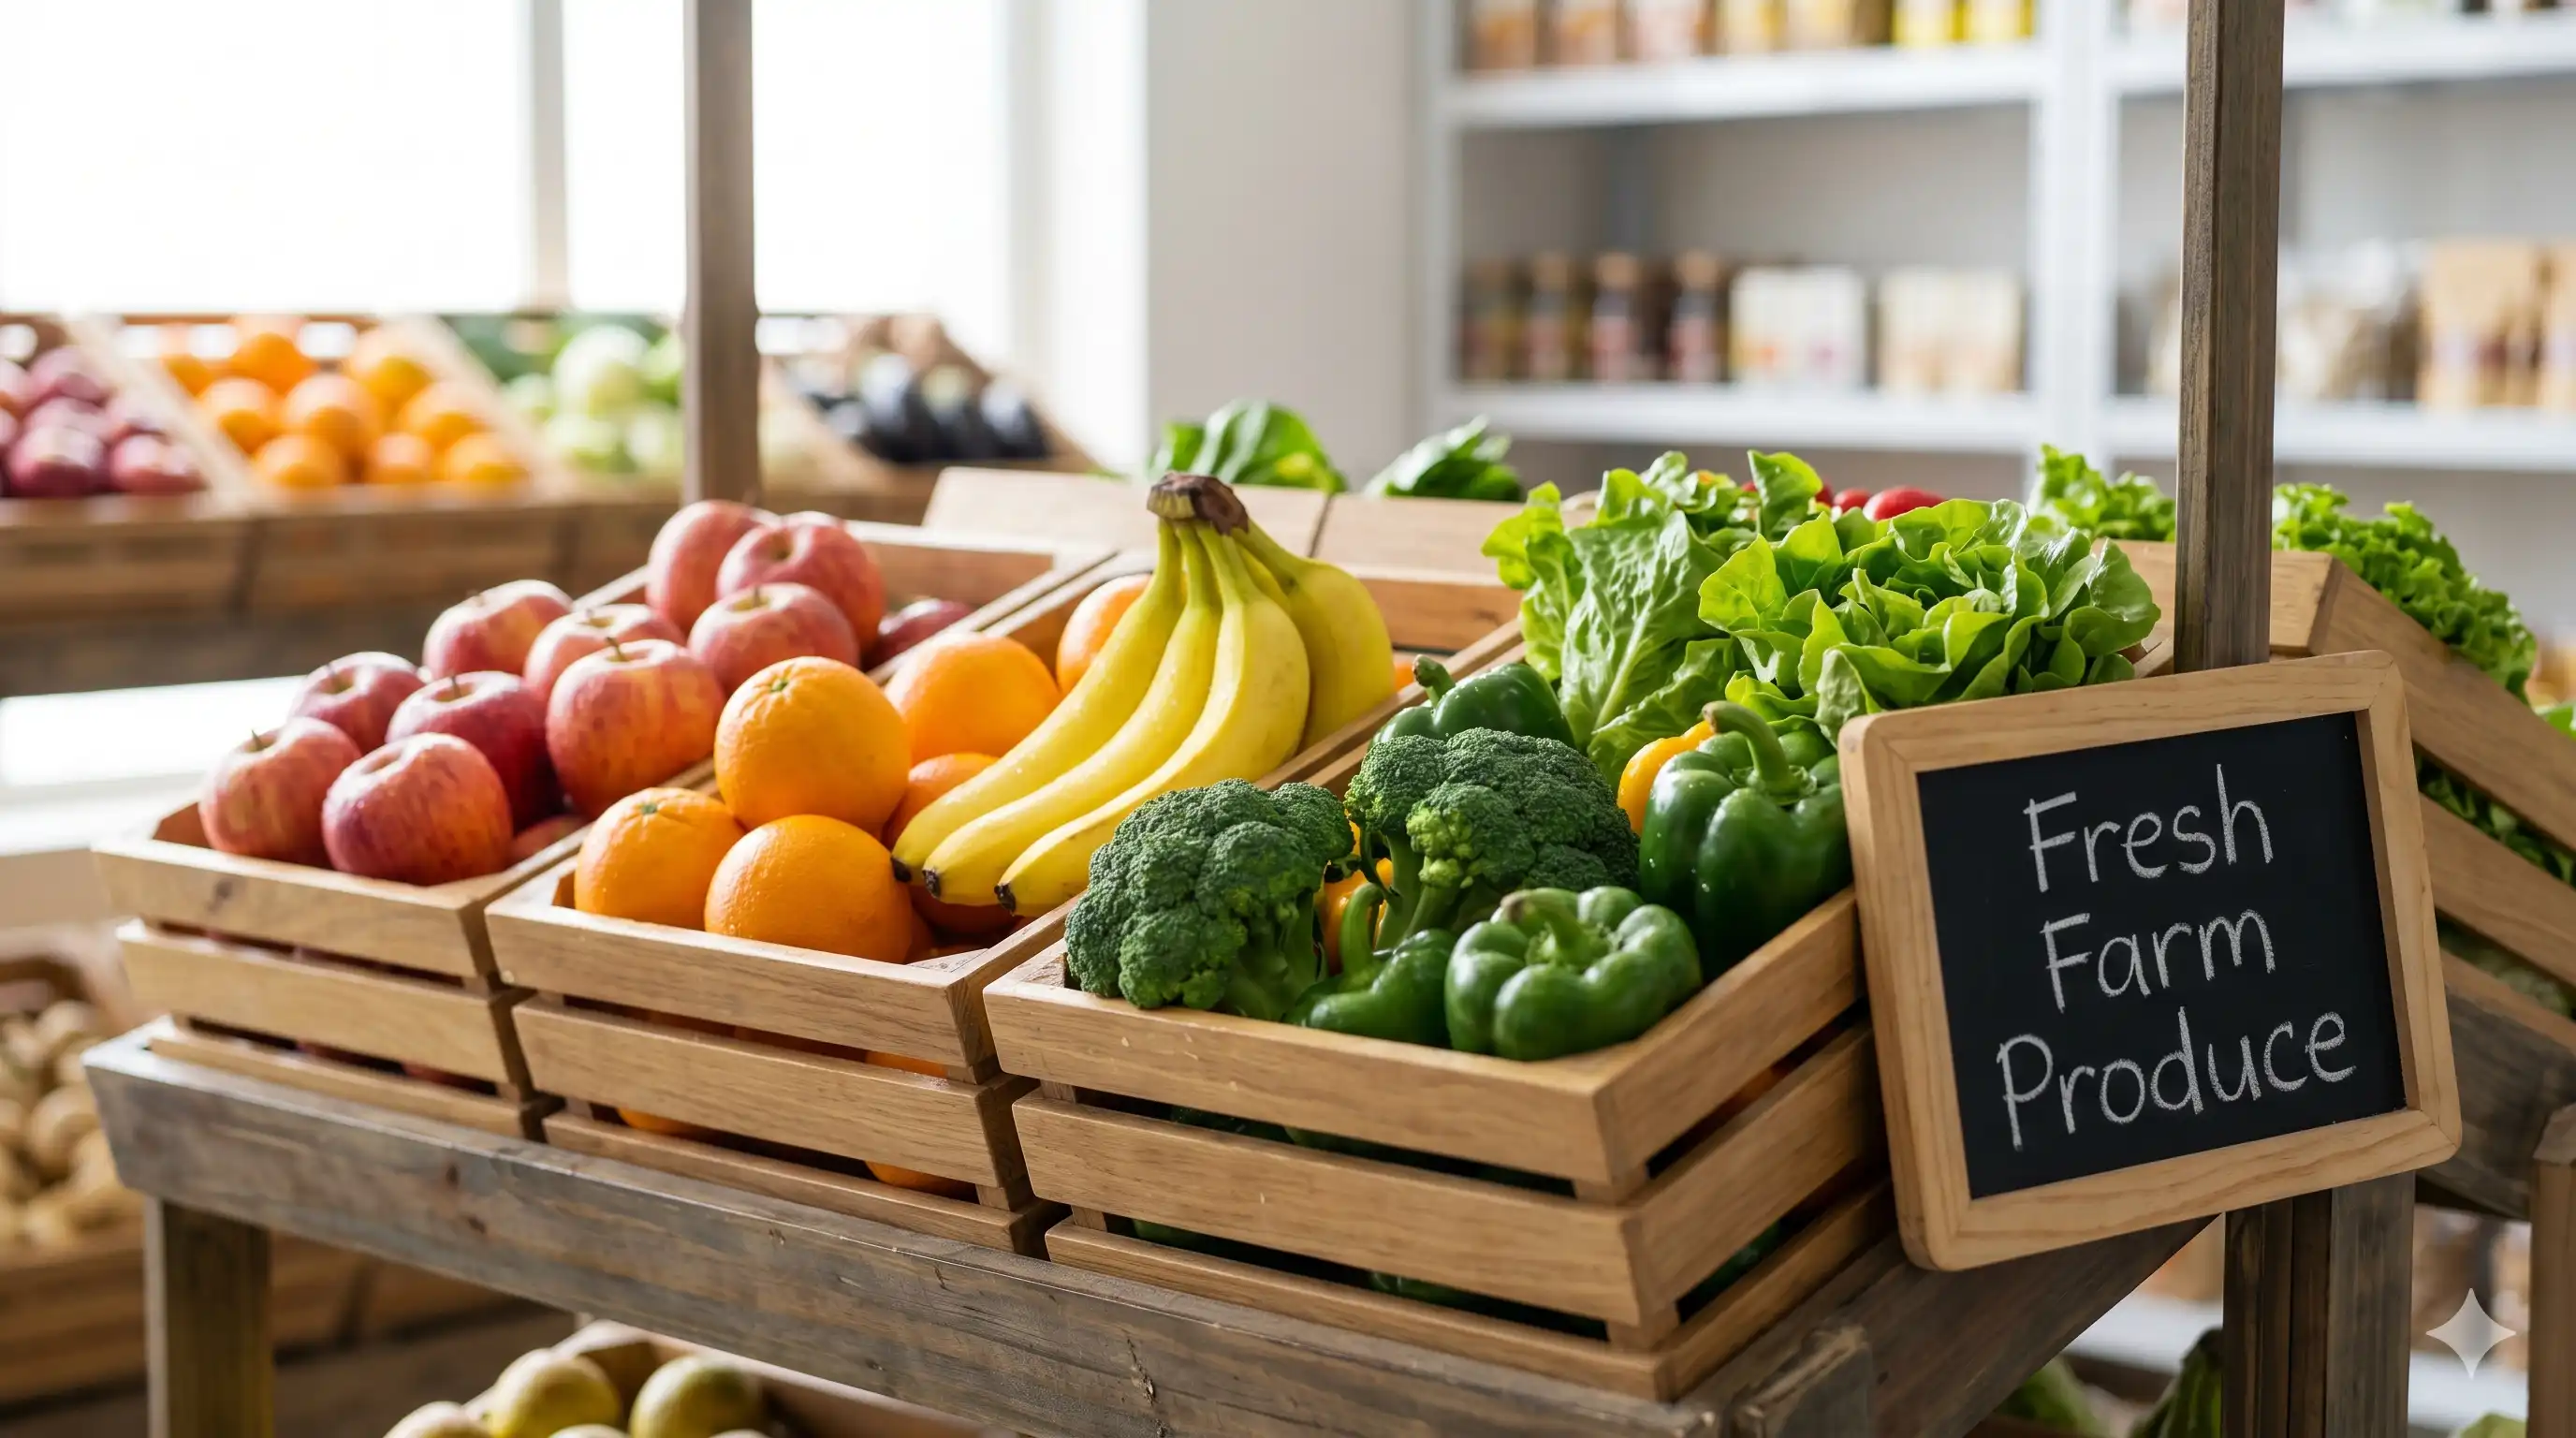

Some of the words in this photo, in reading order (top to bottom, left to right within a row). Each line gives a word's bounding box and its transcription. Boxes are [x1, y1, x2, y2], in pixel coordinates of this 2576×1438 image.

[2023, 763, 2274, 893] Fresh
[2040, 908, 2276, 1013] Farm
[1996, 1005, 2357, 1152] Produce
